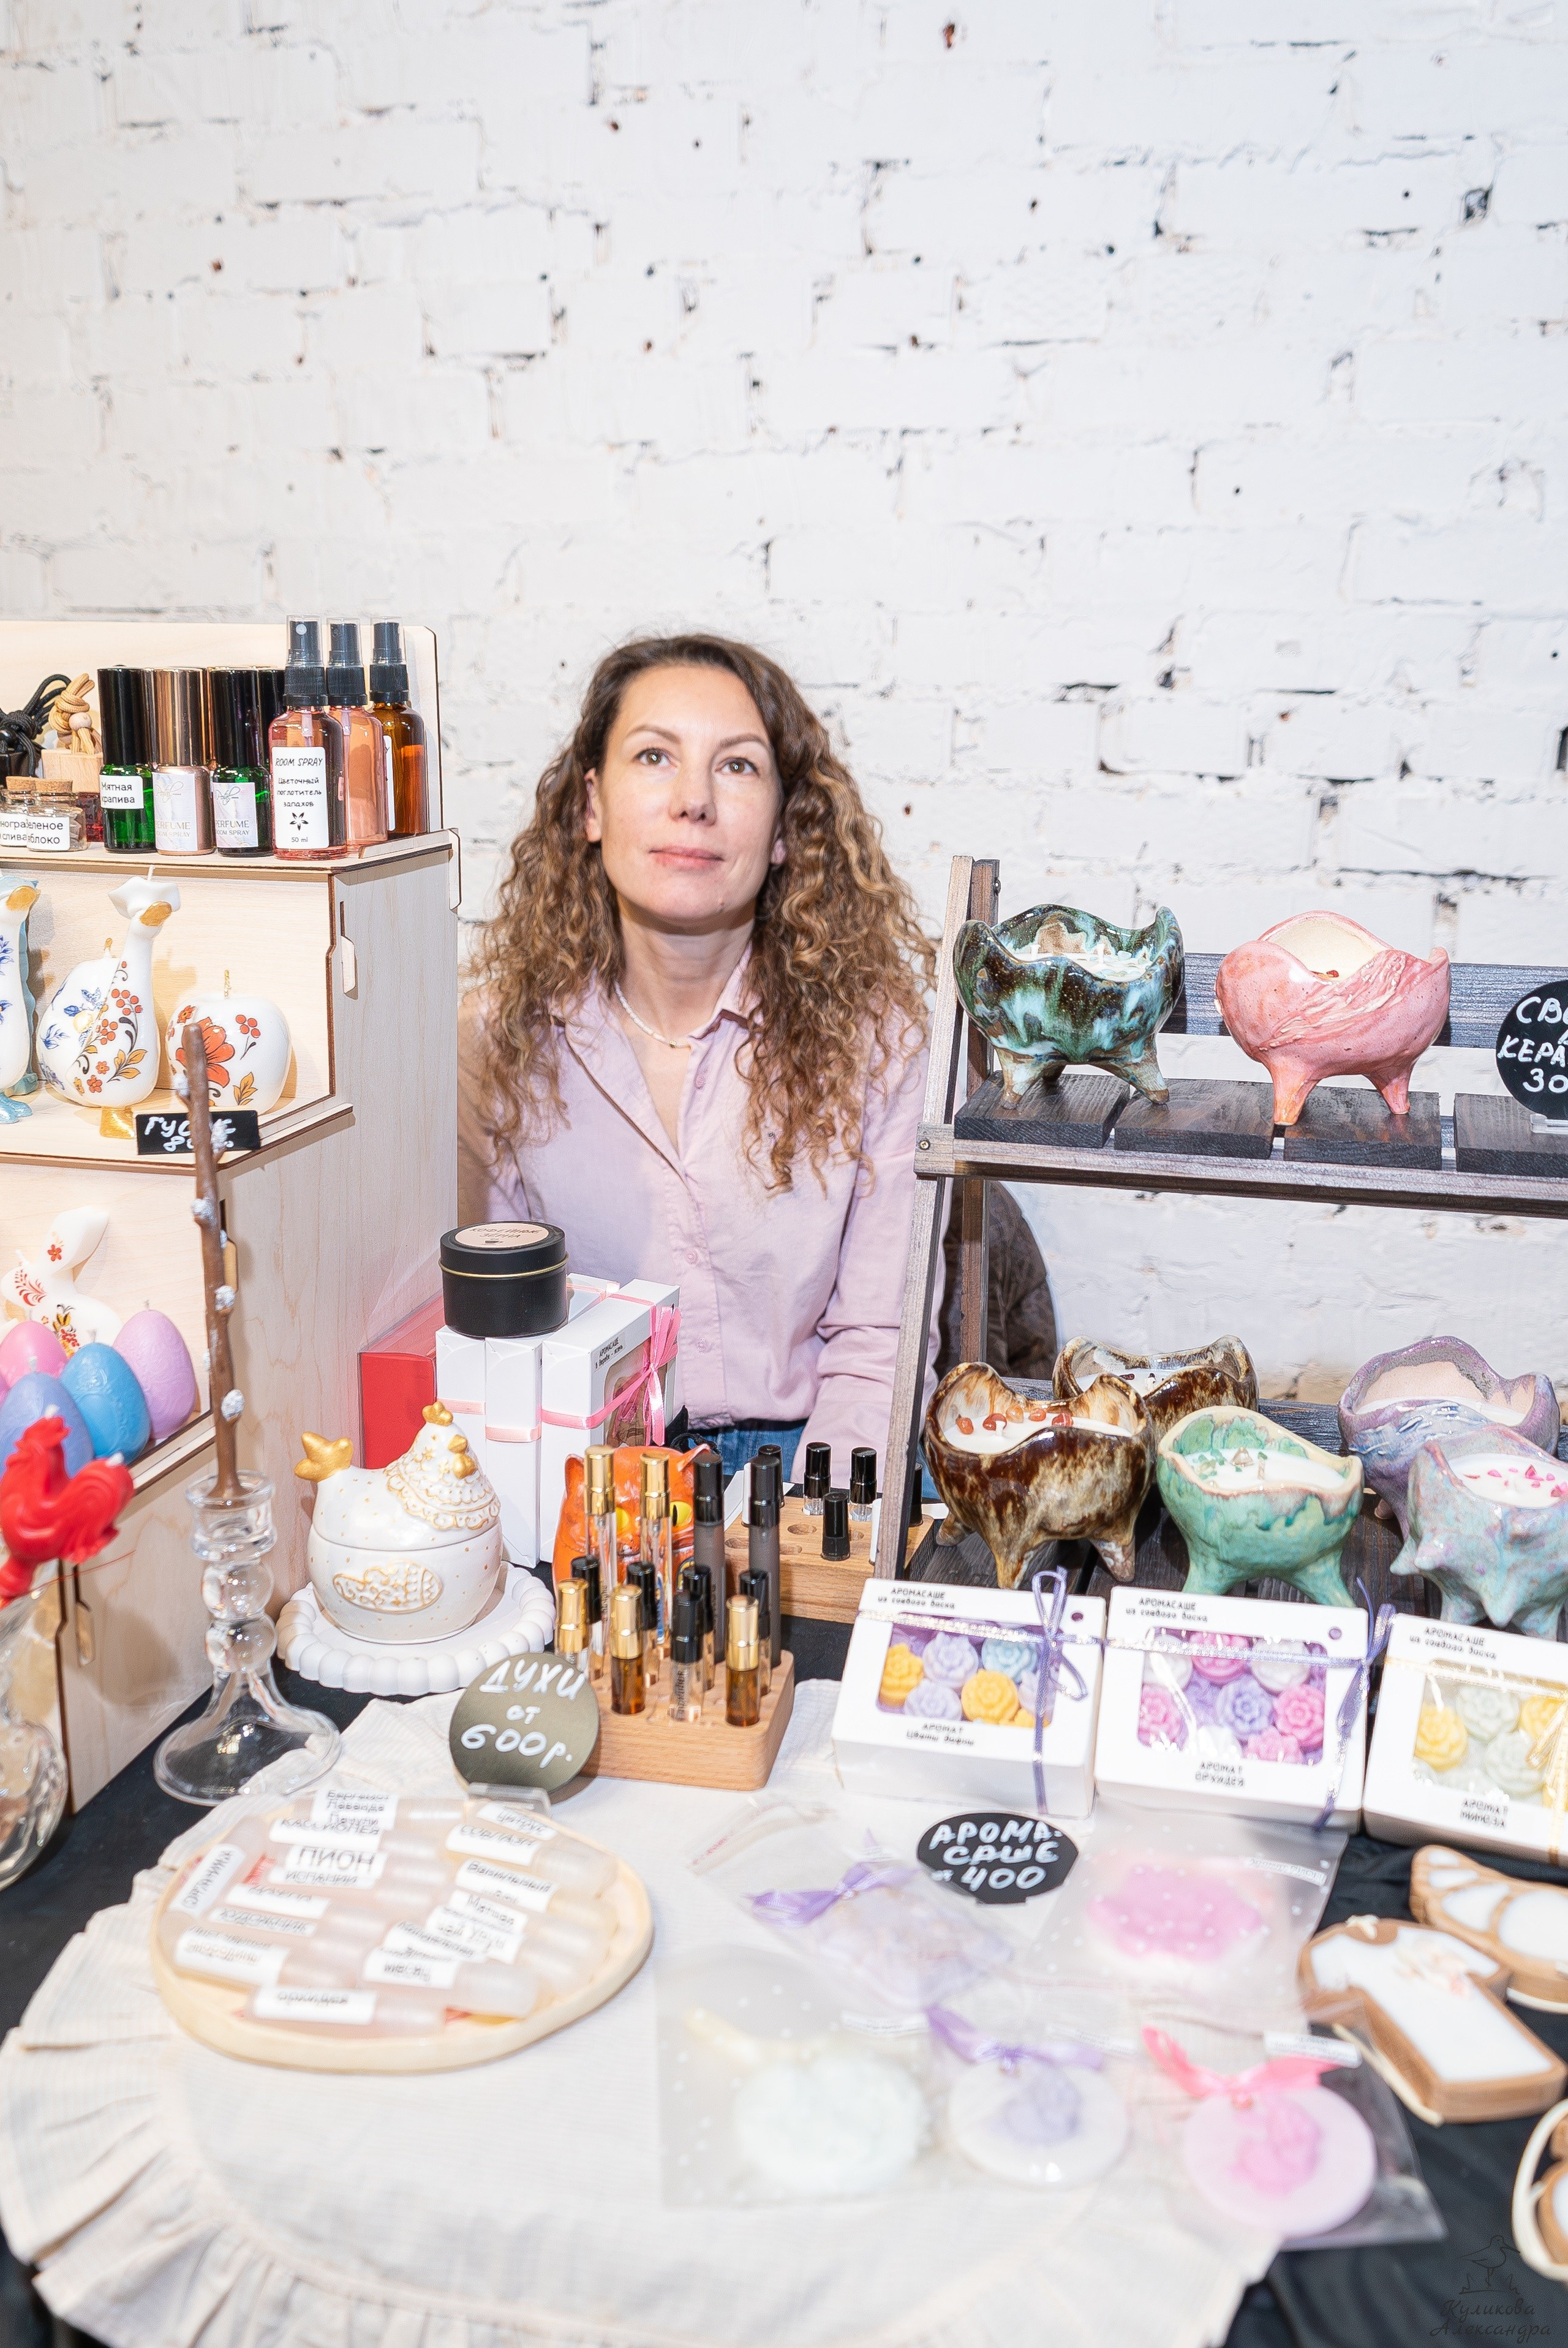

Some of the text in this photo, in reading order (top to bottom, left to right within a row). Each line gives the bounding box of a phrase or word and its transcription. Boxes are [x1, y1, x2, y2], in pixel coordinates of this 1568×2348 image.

[276, 758, 323, 766] ROOM SPRAY
[102, 796, 135, 805] рапива
[26, 819, 63, 830] еленое
[1517, 996, 1568, 1024] СВ
[1497, 1035, 1568, 1067] КЕРА
[891, 1587, 946, 1599] АРОМАСАШЕ
[1139, 1596, 1196, 1610] АРОМАСАШЕ
[1424, 1626, 1485, 1647] АРОМАСАШЕ
[479, 1658, 587, 1701] ДУХИ
[506, 1704, 541, 1725] от
[298, 1846, 376, 1873] ПИОН
[943, 1841, 1060, 1866] САШЕ
[961, 1866, 1047, 1892] 400
